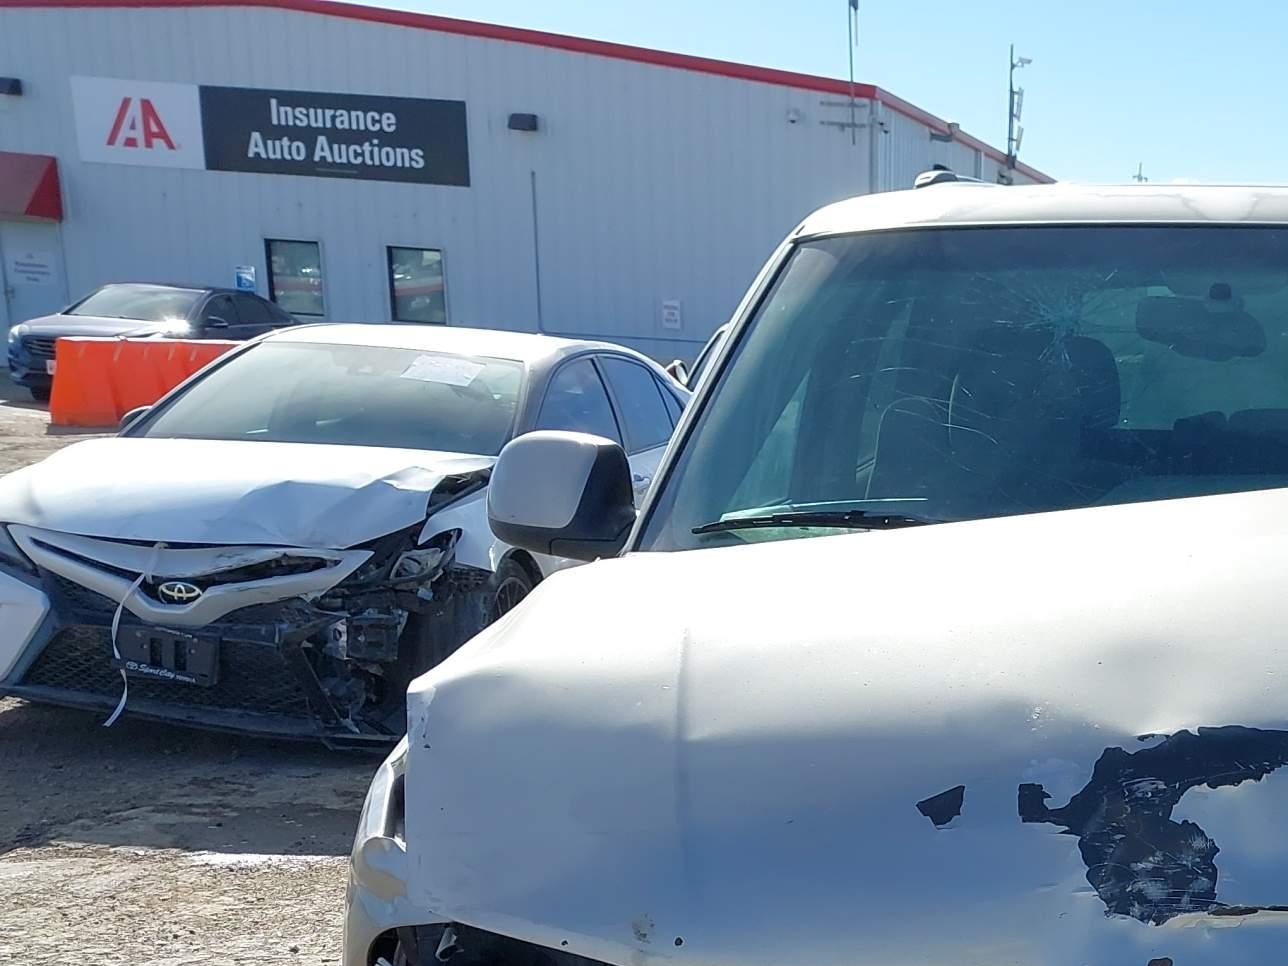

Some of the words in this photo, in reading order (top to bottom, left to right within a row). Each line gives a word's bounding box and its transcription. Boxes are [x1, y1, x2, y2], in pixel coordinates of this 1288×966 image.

[269, 98, 397, 133] Insurance
[247, 131, 306, 161] Auto
[313, 135, 425, 169] Auctions
